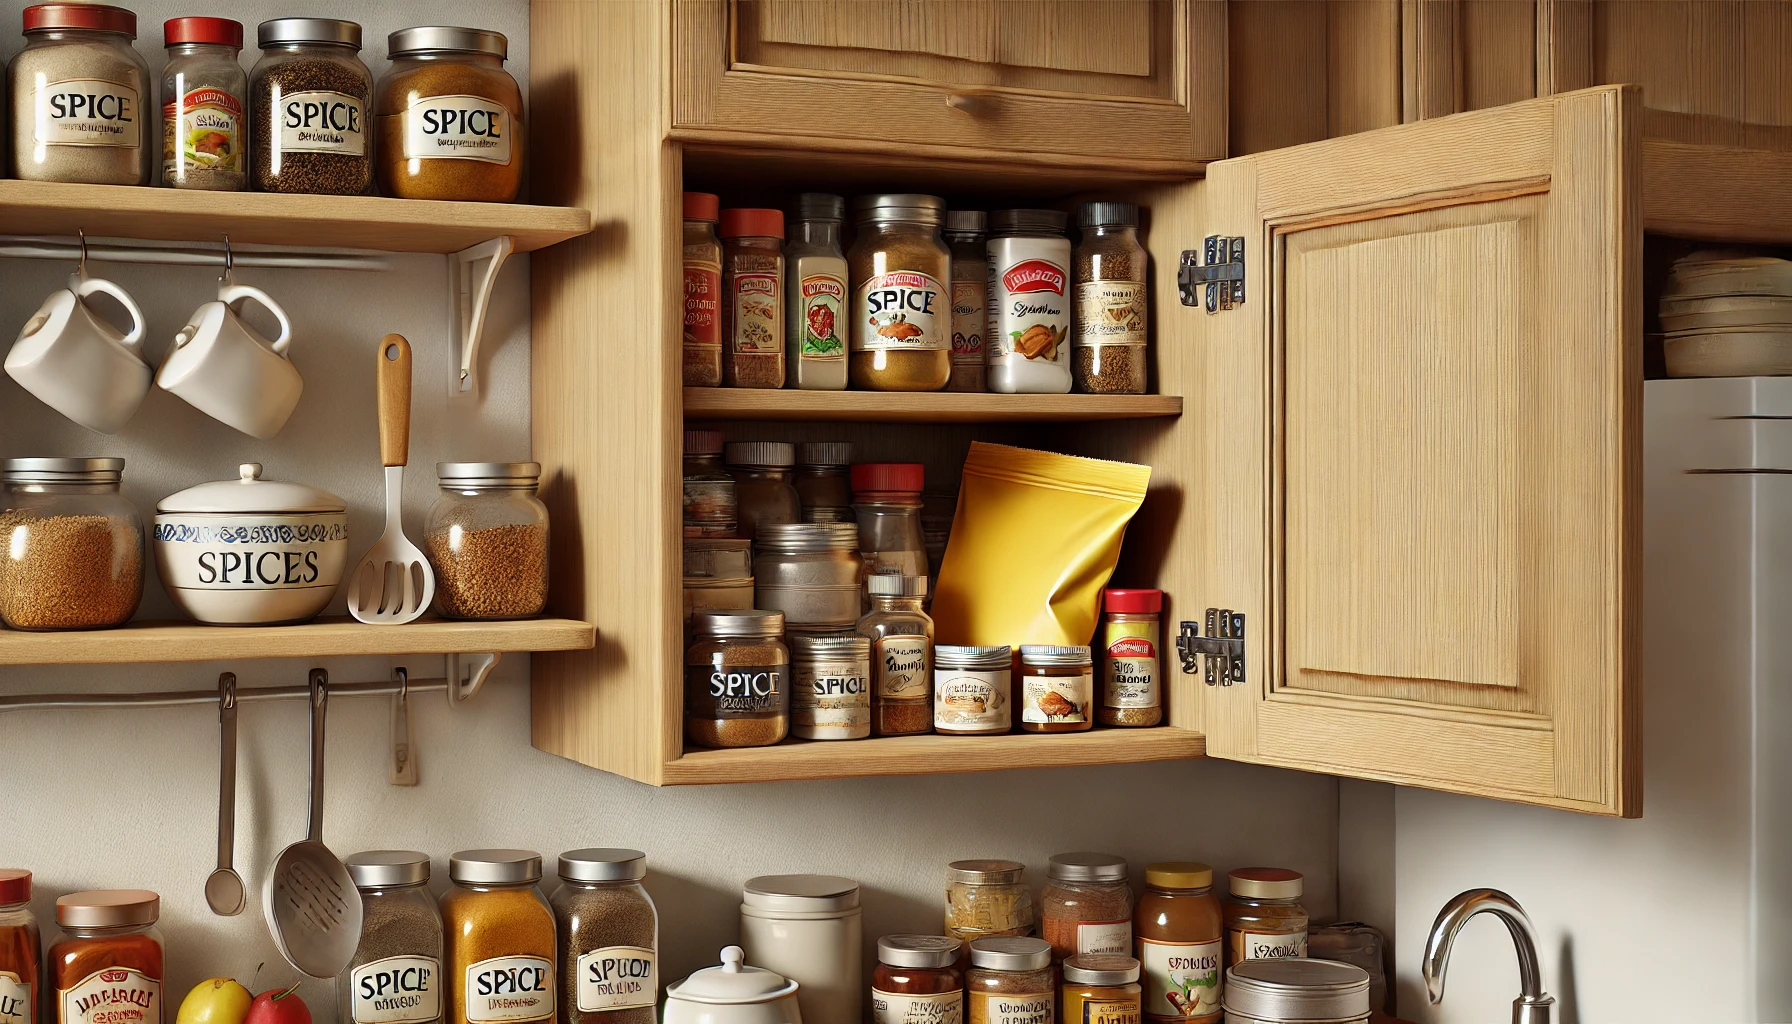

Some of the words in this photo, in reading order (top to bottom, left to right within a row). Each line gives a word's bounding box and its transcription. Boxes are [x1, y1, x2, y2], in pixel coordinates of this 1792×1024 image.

[50, 93, 132, 123] SPICE
[286, 101, 361, 133] SPICE
[422, 108, 501, 138] SPICE
[867, 288, 937, 315] SPICE
[198, 550, 319, 584] SPICES
